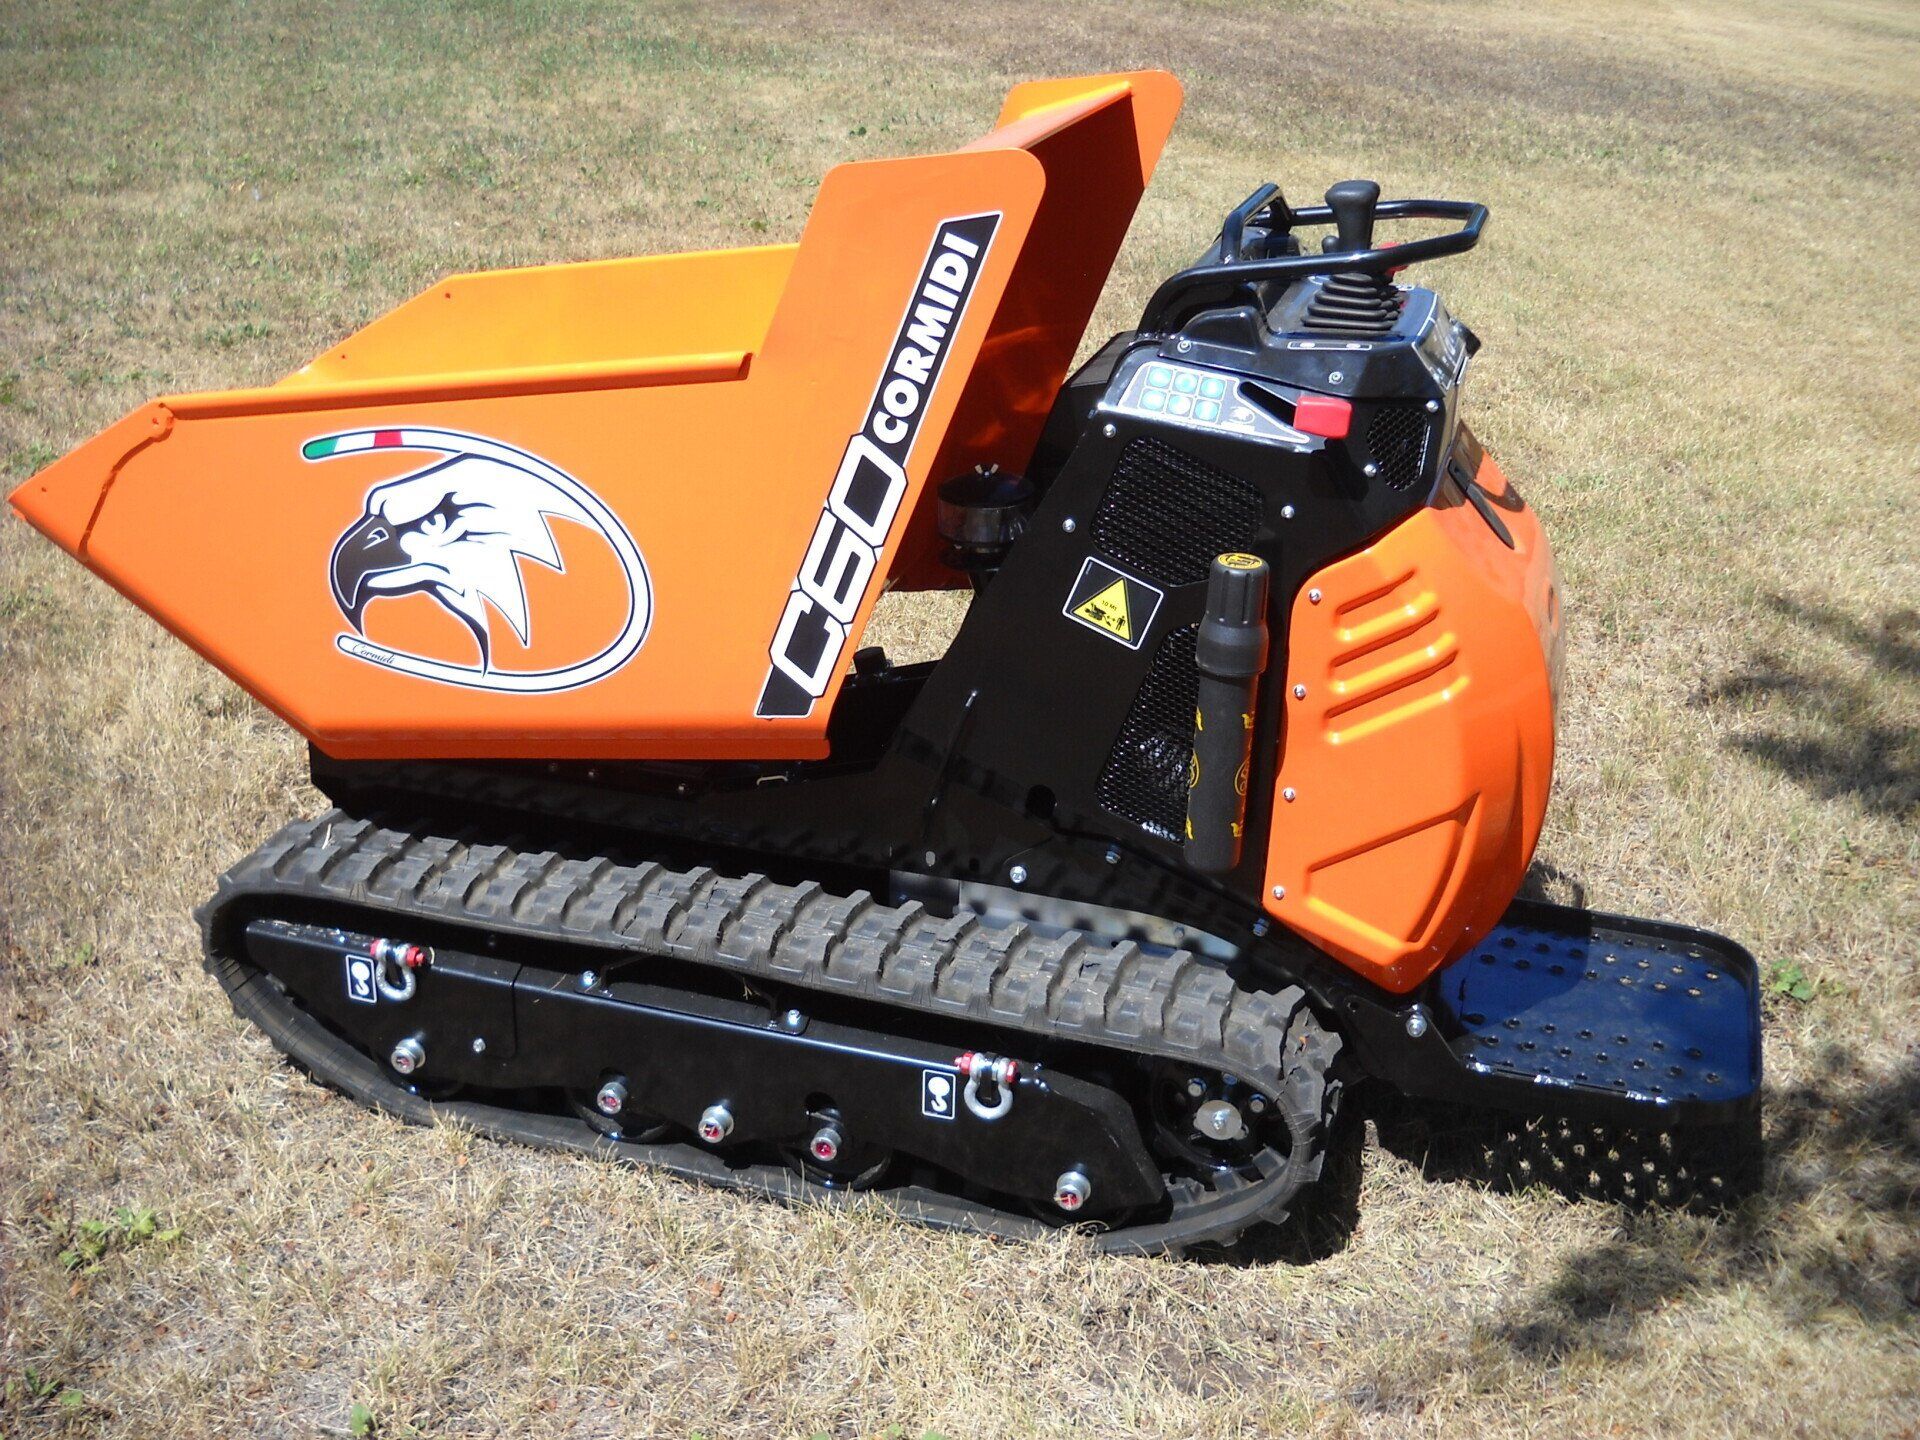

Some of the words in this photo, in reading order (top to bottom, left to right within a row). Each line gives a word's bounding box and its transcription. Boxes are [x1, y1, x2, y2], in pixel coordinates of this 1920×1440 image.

[769, 433, 909, 698] C60
[872, 232, 980, 445] CORMIDI
[352, 643, 395, 664] Cormidi
